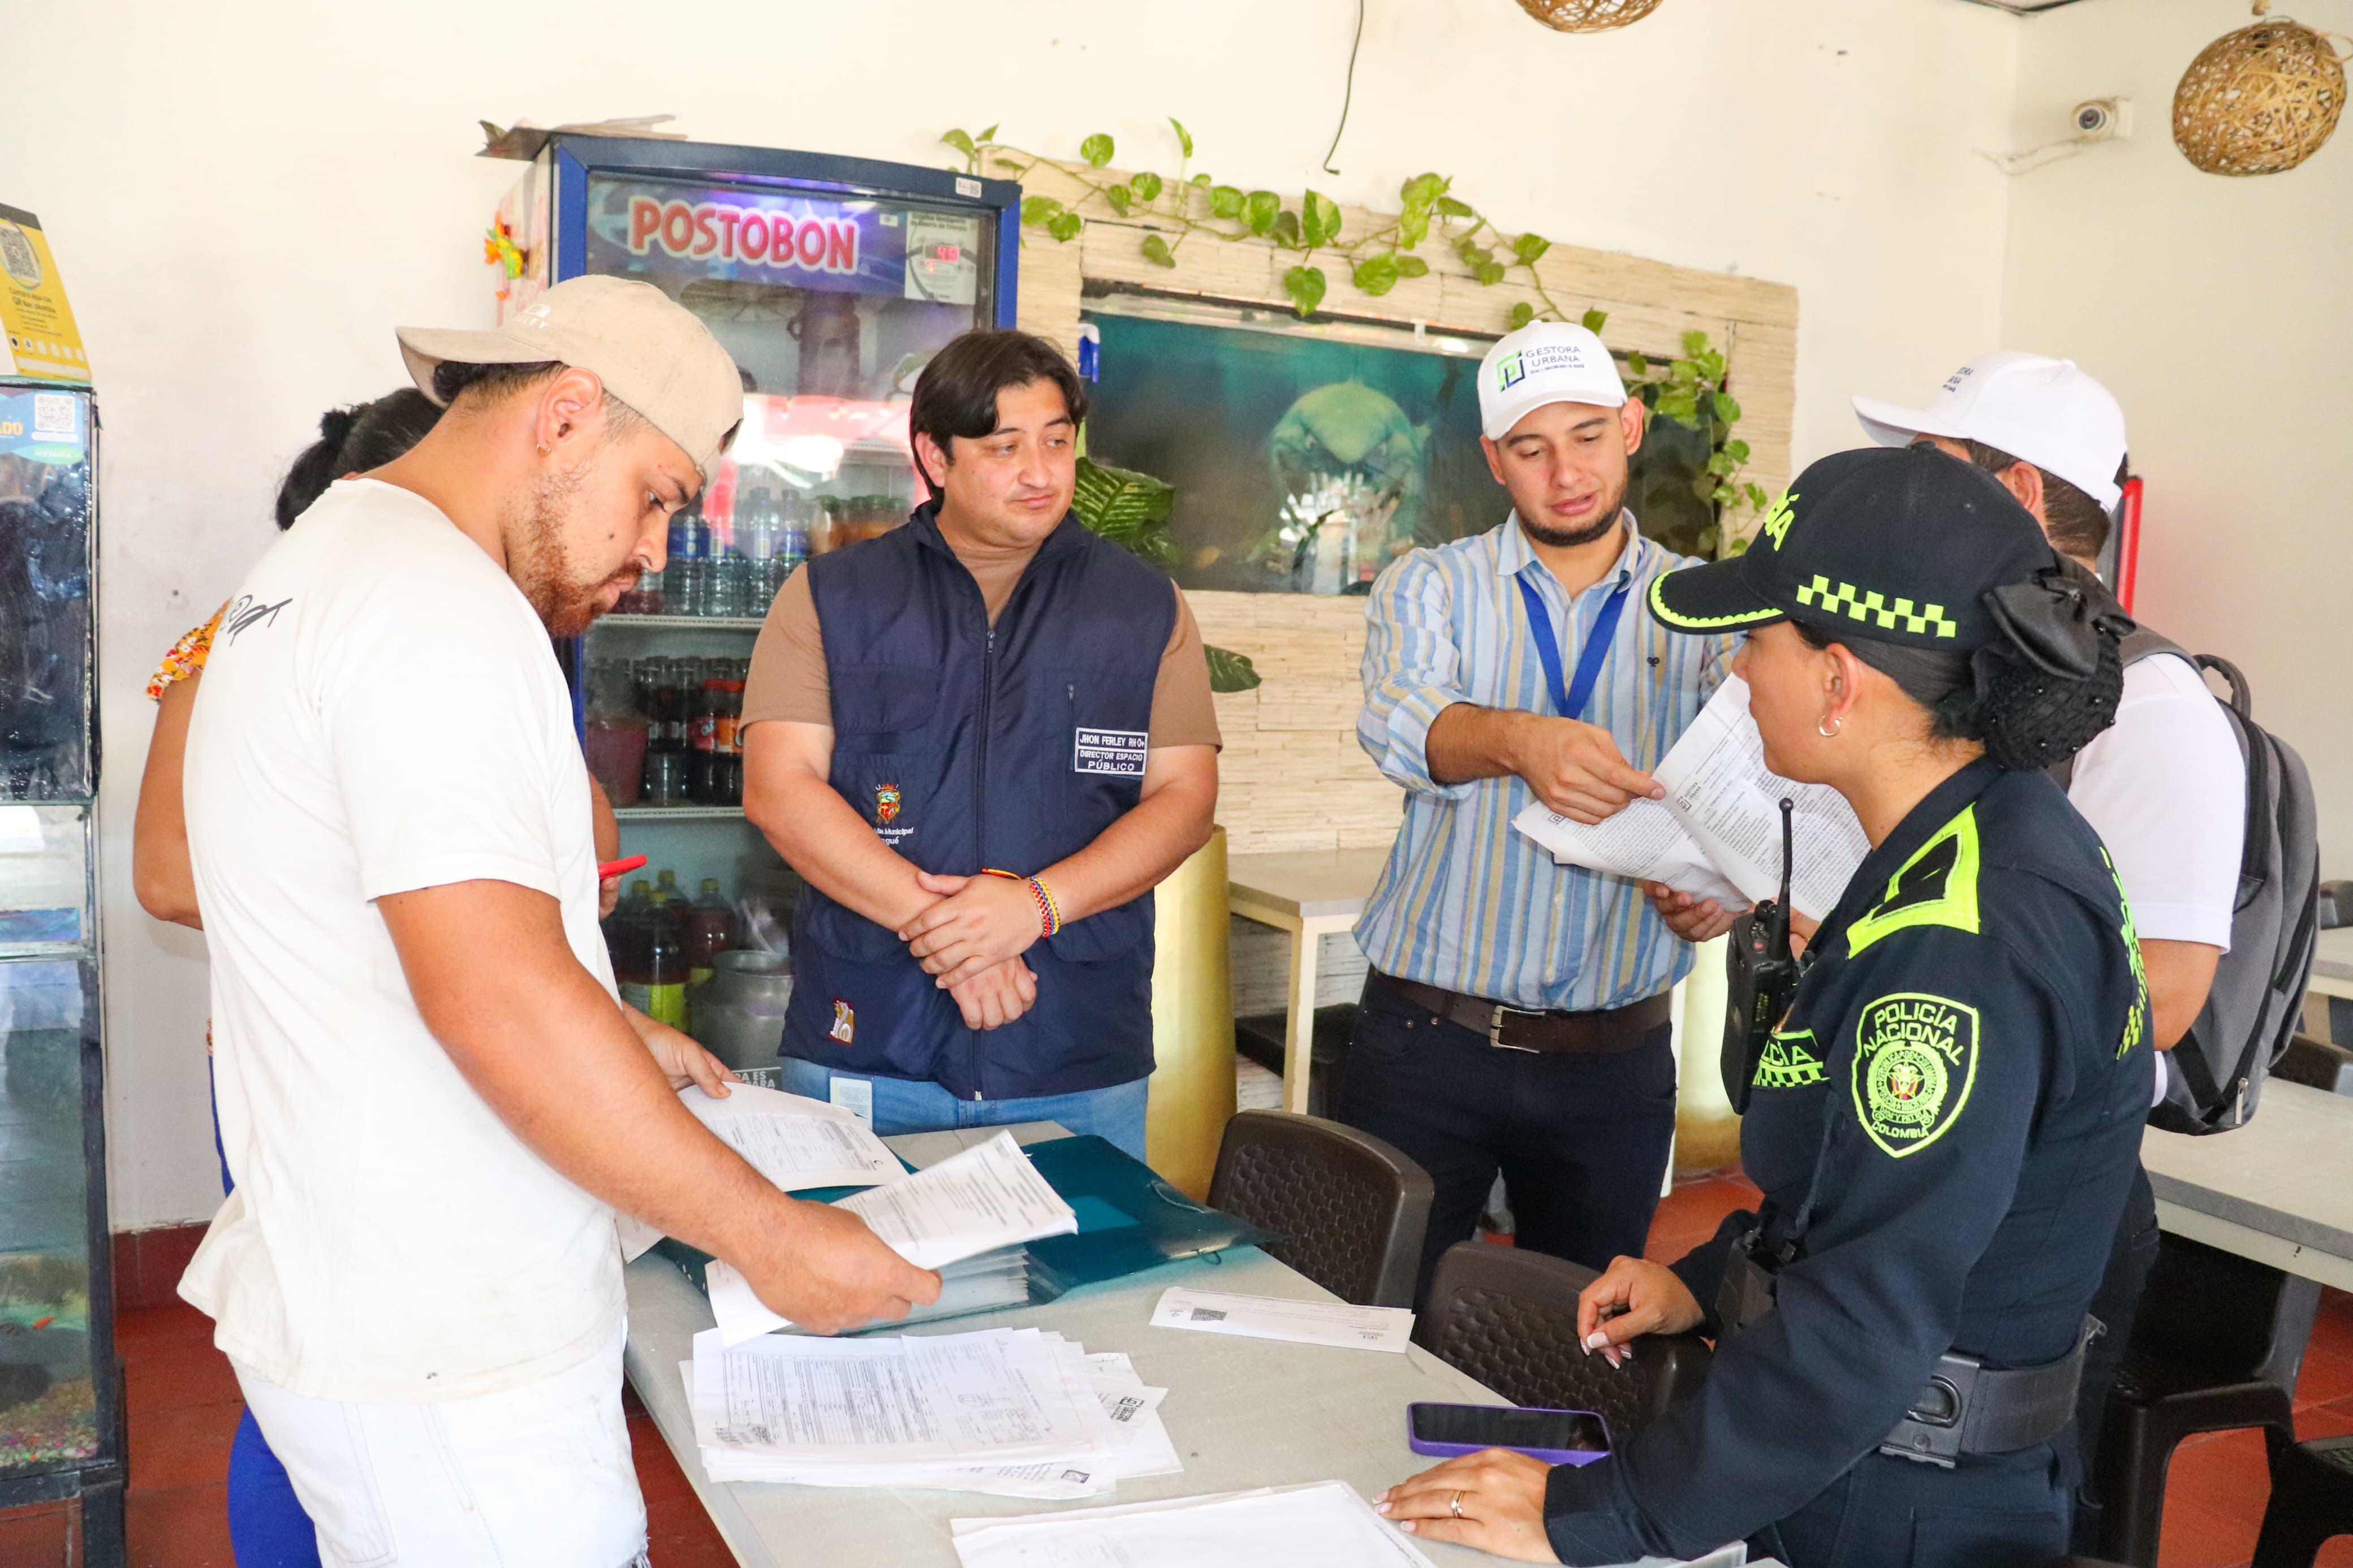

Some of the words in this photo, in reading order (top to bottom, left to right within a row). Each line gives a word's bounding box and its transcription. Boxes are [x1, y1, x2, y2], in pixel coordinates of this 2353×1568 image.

[632, 199, 856, 271] POSTOBON
[1526, 346, 1581, 357] GESTORA
[1532, 355, 1580, 366] URBANA
[0, 420, 23, 436] DO
[1080, 734, 1099, 745] JHON
[1102, 736, 1126, 746] FERLEY
[1080, 750, 1114, 760] DIRECTOR
[1116, 753, 1143, 762] ESPACIO
[1088, 759, 1135, 771] PÚBLICO
[885, 827, 914, 836] Municipal
[1874, 1002, 1957, 1035] POLICÍA
[1863, 1022, 1964, 1066] NACIONAL
[753, 1070, 766, 1081] ES
[1872, 1121, 1929, 1138] COLOMBIA
